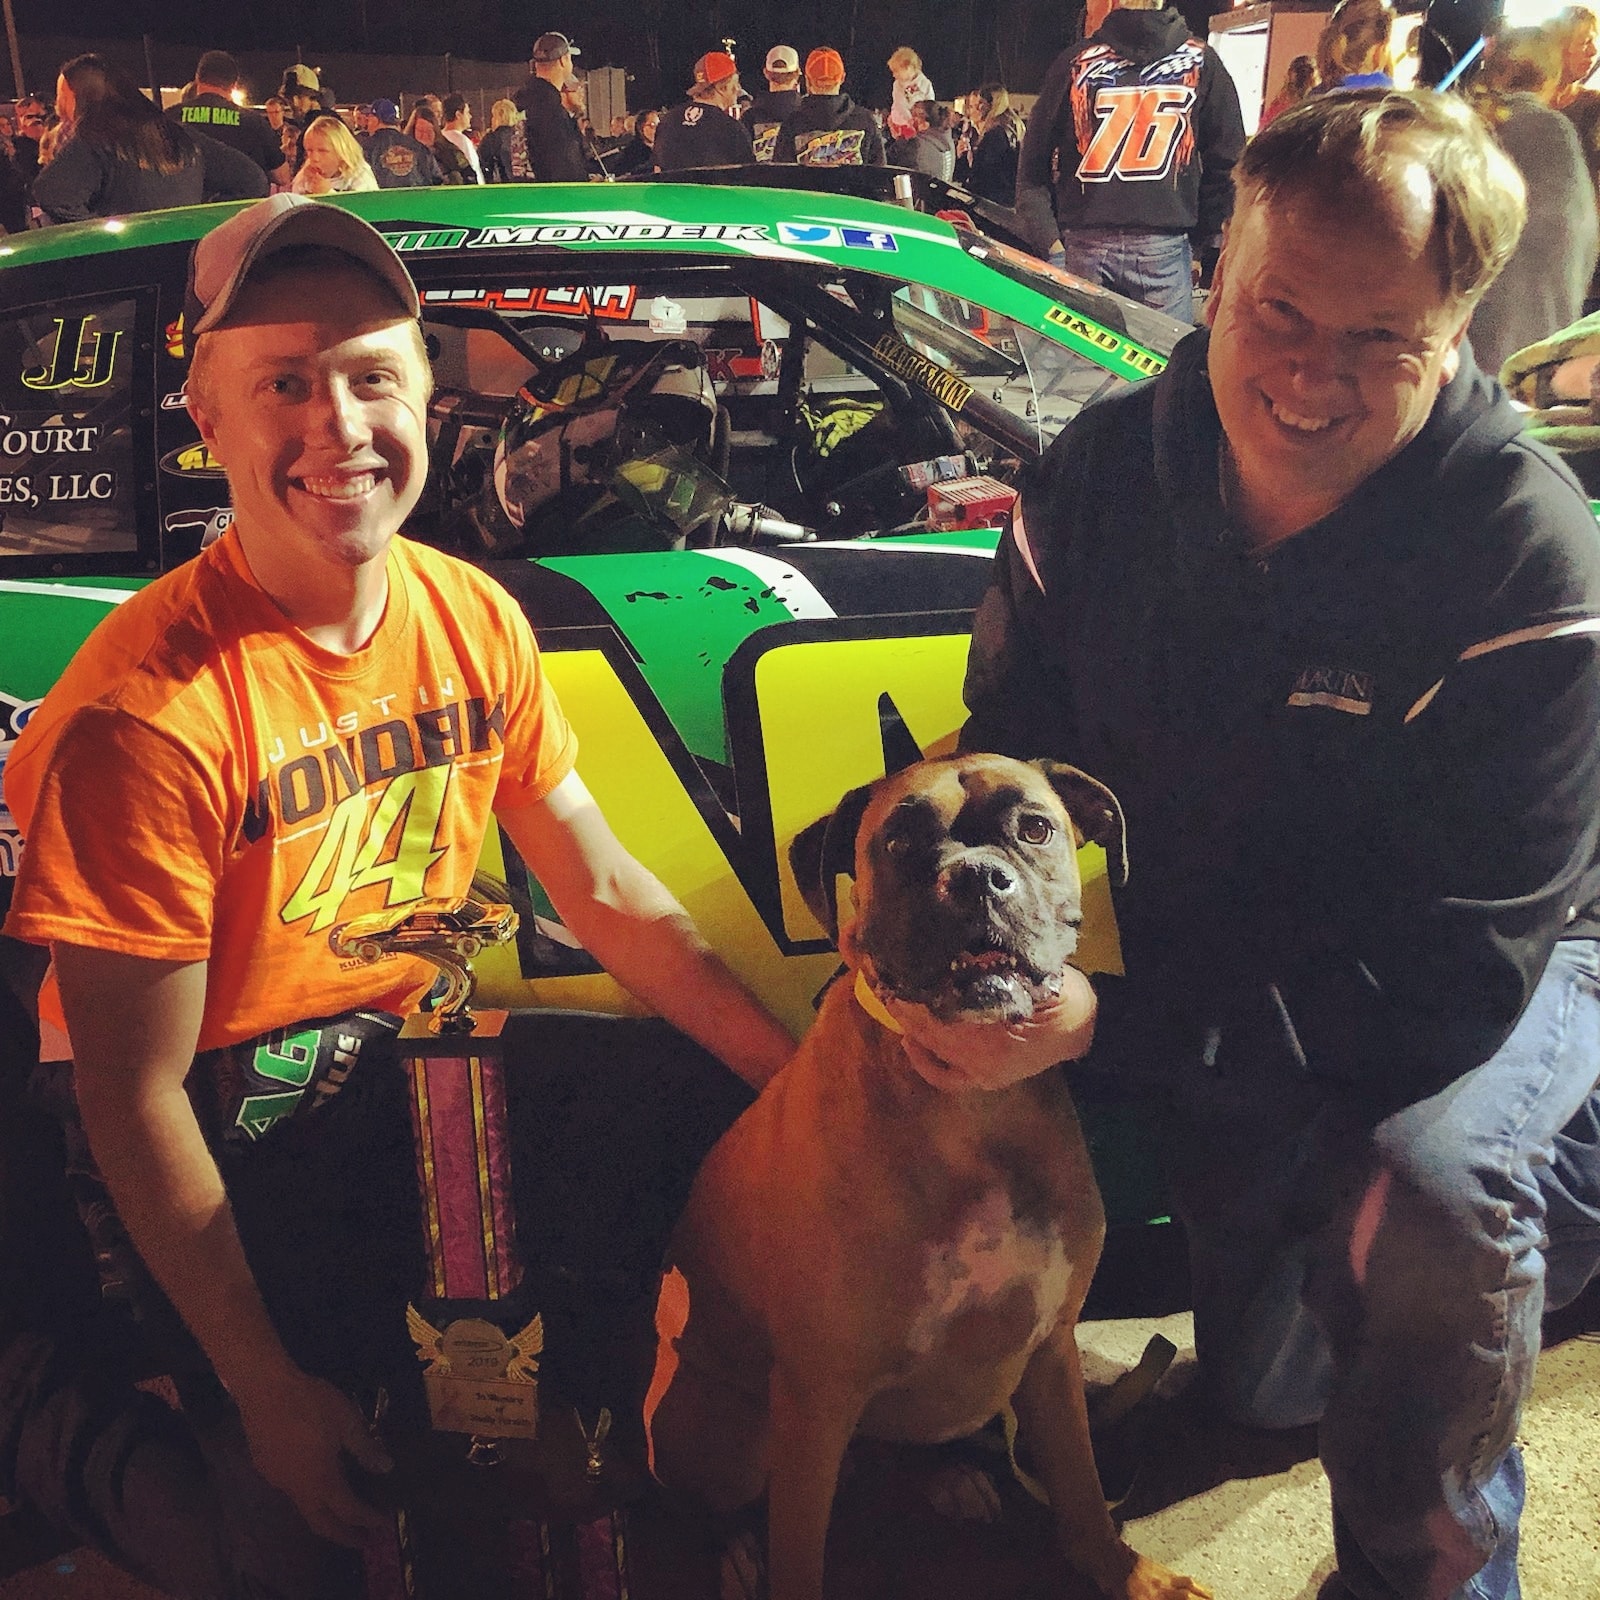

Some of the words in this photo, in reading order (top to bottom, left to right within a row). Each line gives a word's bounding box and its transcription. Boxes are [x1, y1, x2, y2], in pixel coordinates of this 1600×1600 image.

[181, 106, 211, 123] TEAM
[1075, 84, 1197, 182] 76
[468, 222, 780, 250] MONDEIK
[1044, 305, 1121, 353] D&D
[49, 472, 112, 501] LLC
[268, 677, 454, 764] JUSTIN
[278, 763, 453, 937] 44
